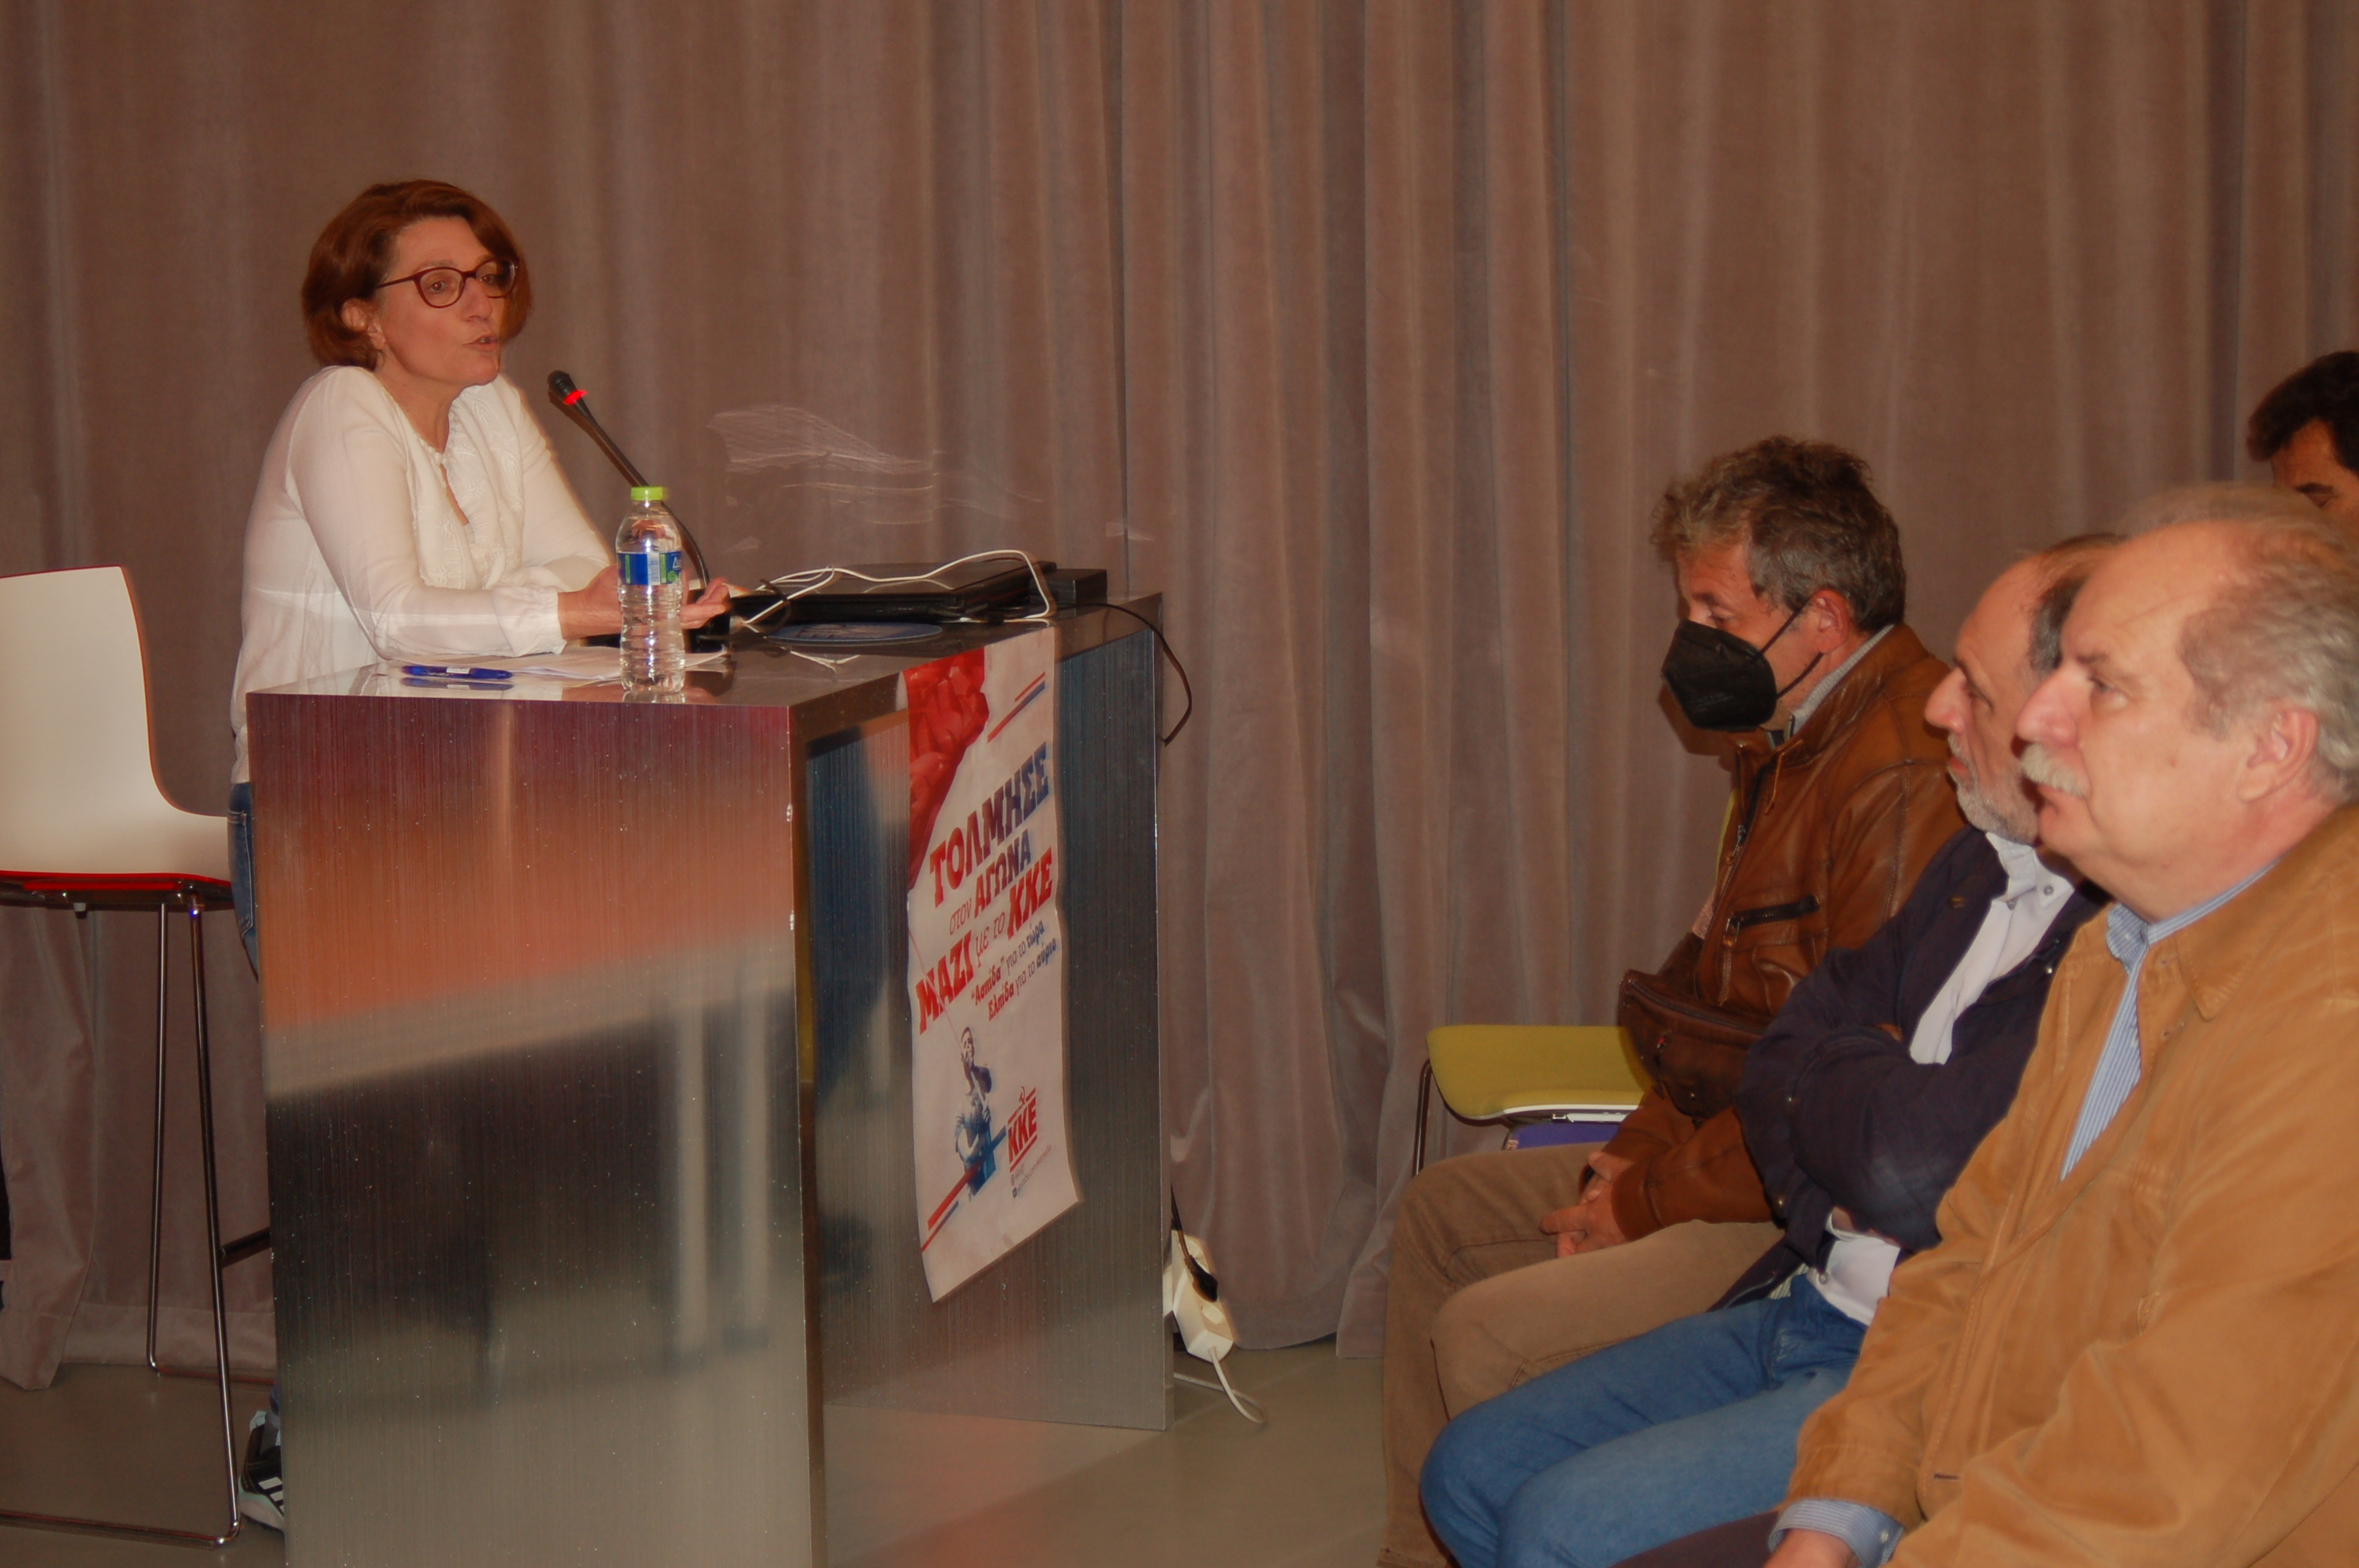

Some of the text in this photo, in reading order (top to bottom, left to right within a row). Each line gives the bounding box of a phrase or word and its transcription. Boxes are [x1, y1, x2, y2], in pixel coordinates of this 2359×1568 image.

[930, 741, 1049, 909] ΤΟΛΜΗΣΕ
[950, 828, 1031, 935] στον ΑΓΩΝΑ
[915, 847, 1052, 1036] ΜΑΖΙ με το ΚΚΕ
[988, 981, 1015, 1022] Ελπίδα
[1008, 1097, 1038, 1164] ΚΚΕ
